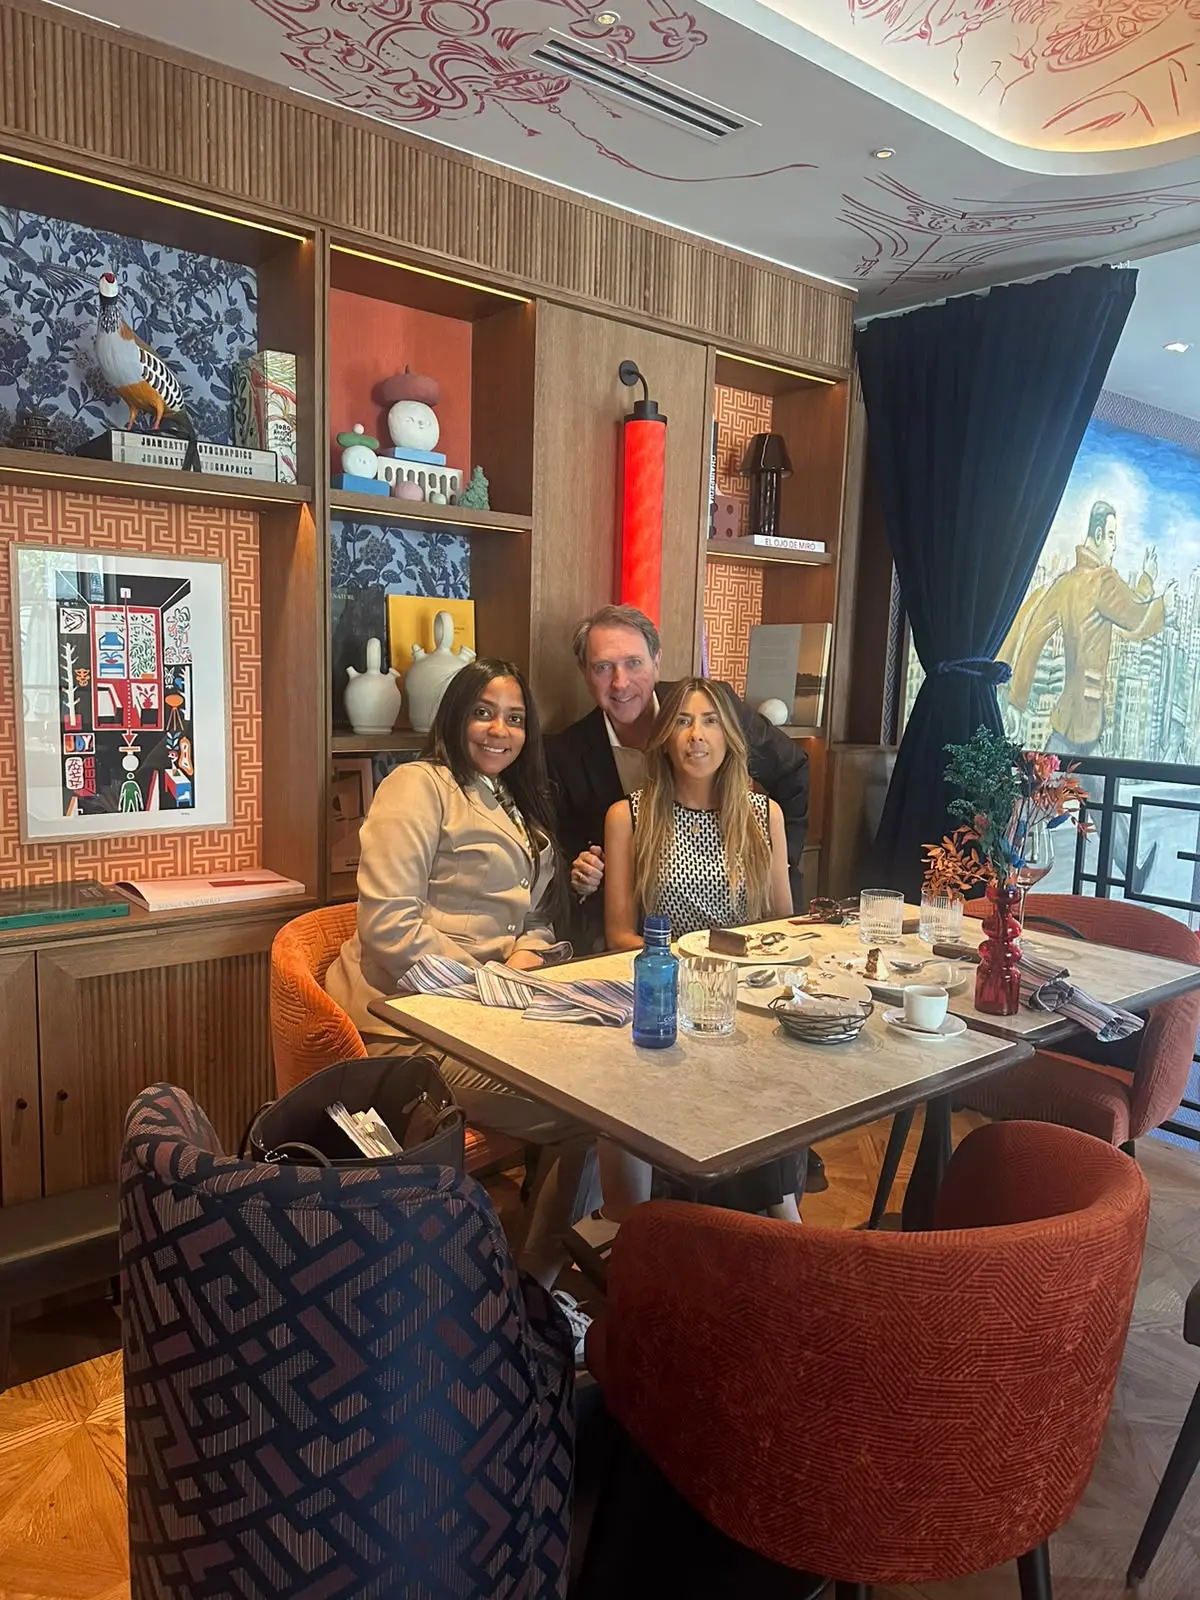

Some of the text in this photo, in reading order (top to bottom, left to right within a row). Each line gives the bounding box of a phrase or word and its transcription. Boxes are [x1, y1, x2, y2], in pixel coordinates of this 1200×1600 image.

[765, 538, 772, 546] EL
[774, 538, 788, 548] OJO
[789, 540, 797, 549] DE
